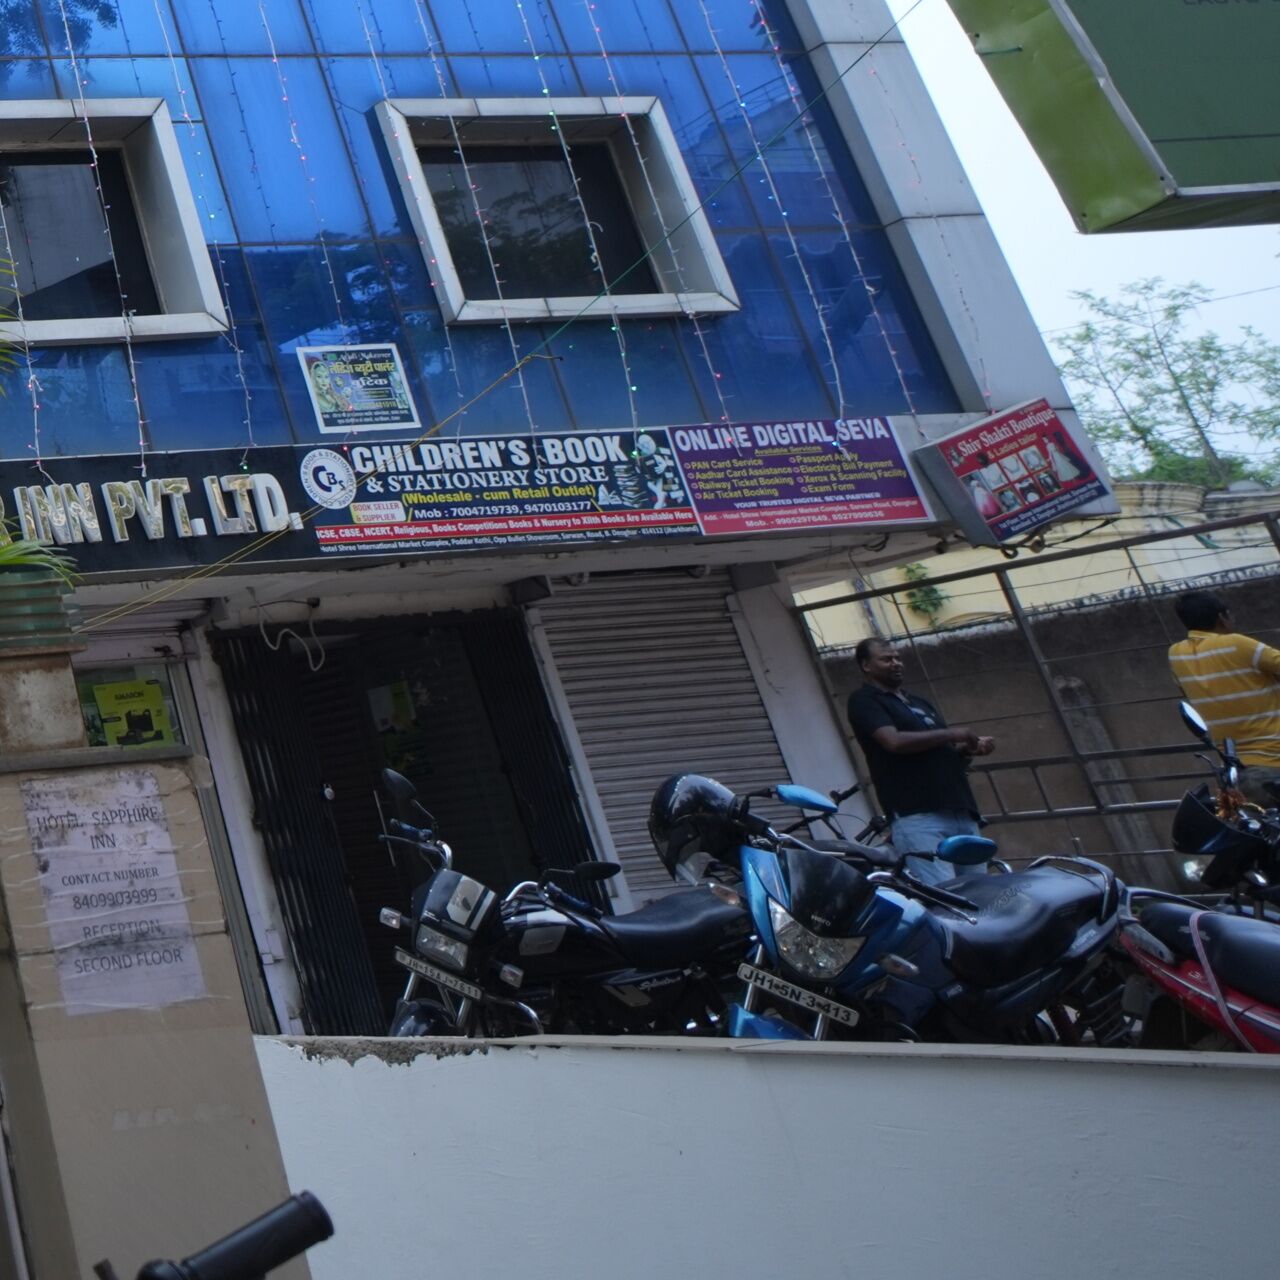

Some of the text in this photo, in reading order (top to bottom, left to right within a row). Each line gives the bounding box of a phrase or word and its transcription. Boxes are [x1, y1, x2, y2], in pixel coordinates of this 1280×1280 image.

[674, 418, 890, 452] ONLINE DIGITAL SEVA
[957, 437, 982, 458] Shiv
[978, 423, 1013, 447] Shakti
[1008, 407, 1056, 434] Boutique
[542, 435, 628, 465] BOOK
[795, 453, 833, 463] Passport
[690, 461, 709, 470] PAN
[711, 460, 731, 469] Card
[726, 469, 747, 478] Card
[856, 460, 894, 470] Payment
[366, 465, 609, 493] & STATIONERY STORE
[698, 476, 794, 489] Railway Ticket Booking
[838, 470, 878, 481] Scanning
[401, 484, 596, 507] (Wholesale cum Retail Outlet)
[703, 487, 779, 500] Air Ticket Booking
[808, 484, 831, 493] Exam
[12, 482, 104, 544] INN
[100, 476, 207, 544] PVT.
[202, 472, 305, 537] LTD.
[352, 502, 400, 512] BOOK SELLER
[414, 509, 442, 519] Mob
[339, 529, 363, 539] CBSE,
[365, 527, 394, 537] NCERT,
[394, 525, 432, 535] Religious,
[432, 523, 457, 532] Books
[459, 520, 507, 532] Competitions
[509, 519, 533, 529] Books
[541, 517, 571, 528] Nursery
[573, 517, 581, 526] to
[601, 514, 626, 524] Books
[626, 513, 640, 522] Are
[640, 512, 674, 522] Available
[675, 511, 693, 520] Here
[362, 513, 396, 522] SUPPLIER
[398, 540, 421, 549] Market
[36, 806, 158, 832] HOTEL SAPPHIRE
[90, 833, 117, 850] INN
[61, 866, 160, 887] CONTACT NUMBER
[72, 888, 158, 910] 8409903999
[82, 919, 163, 940] RECEPTION
[74, 949, 184, 974] SECOND FLOOR
